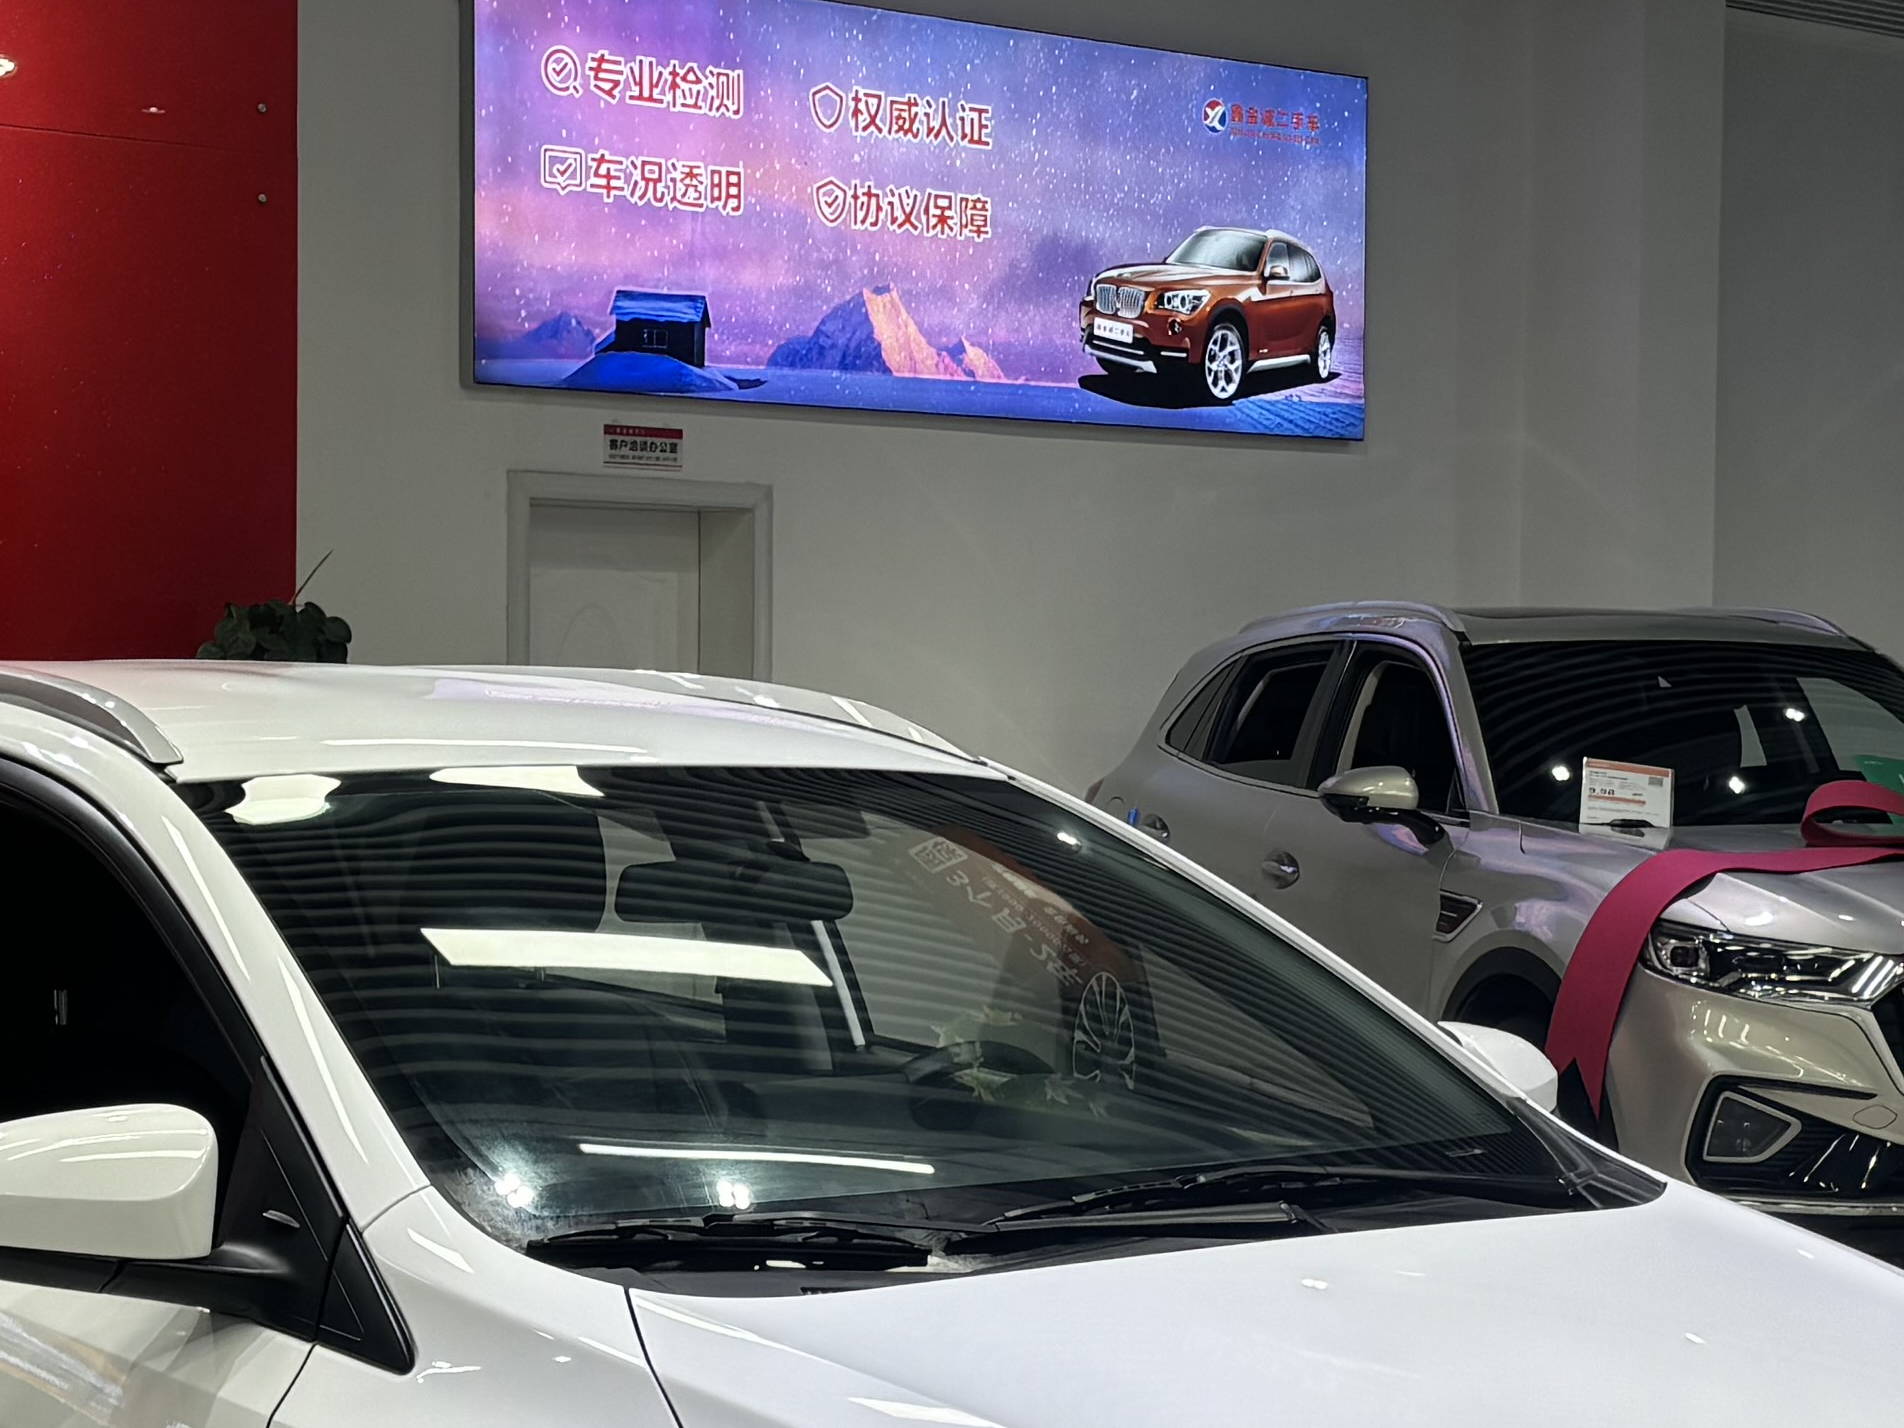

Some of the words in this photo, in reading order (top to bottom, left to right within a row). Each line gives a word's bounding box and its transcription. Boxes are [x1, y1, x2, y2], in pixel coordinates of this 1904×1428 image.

[586, 52, 743, 118] 专业检测
[850, 88, 992, 148] 权威认证
[587, 151, 744, 215] 车况透明
[849, 183, 991, 240] 协议保障
